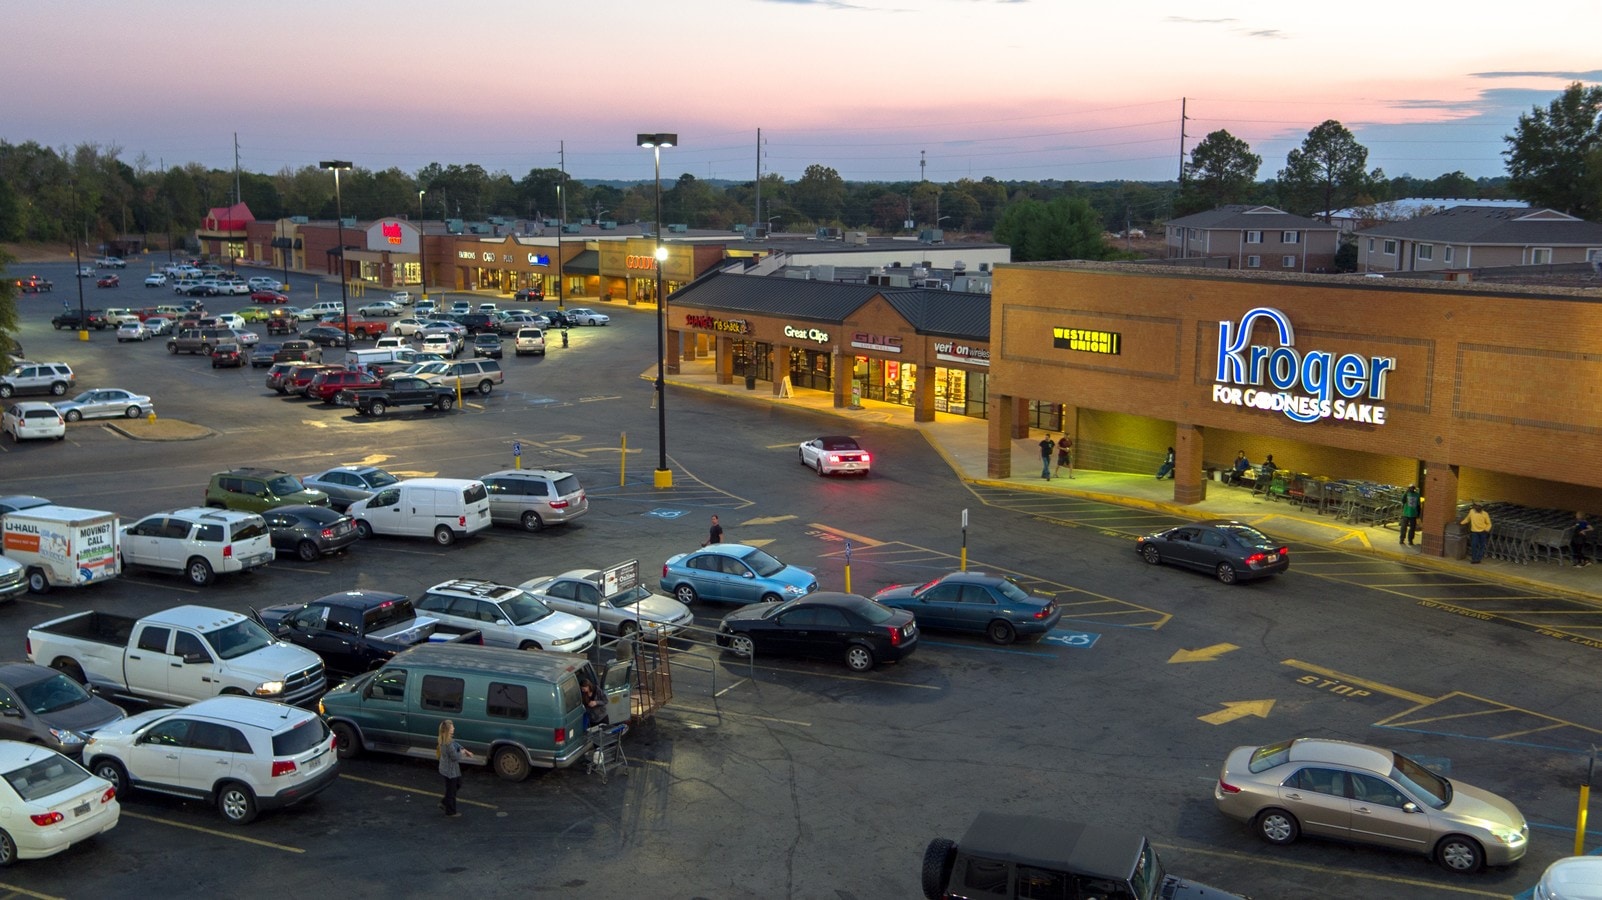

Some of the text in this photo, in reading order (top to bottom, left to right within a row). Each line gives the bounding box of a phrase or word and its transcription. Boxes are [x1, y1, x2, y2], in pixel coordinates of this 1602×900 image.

[784, 325, 829, 344] Great Clips
[851, 331, 903, 348] GNC
[1053, 327, 1108, 343] WESTERN
[934, 341, 990, 359] verizon wireles
[1070, 340, 1108, 353] UNION
[1216, 307, 1396, 423] Kroger
[1212, 384, 1387, 425] FOR GOODNESS SAKE
[5, 522, 40, 534] U-HAUL
[80, 524, 110, 538] MOVING?
[87, 537, 104, 546] CALL
[1296, 675, 1372, 698] STOP
